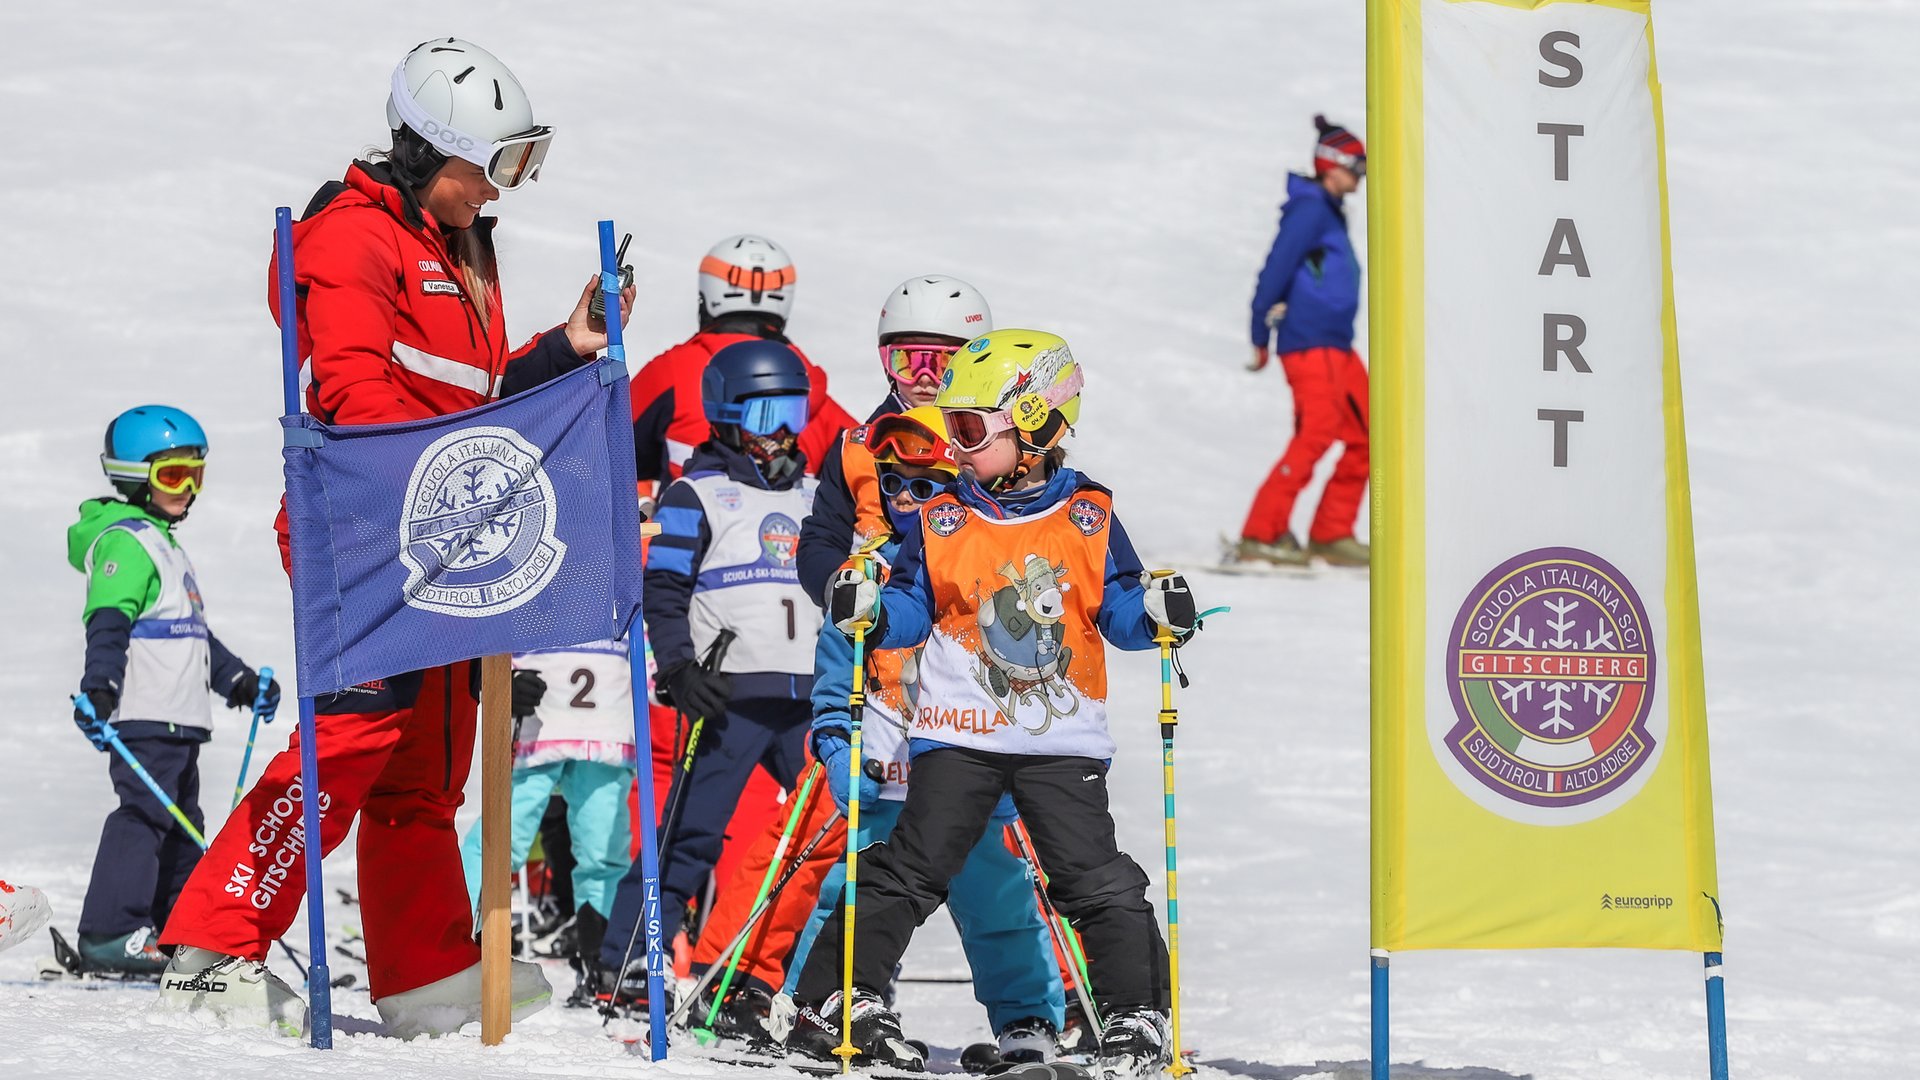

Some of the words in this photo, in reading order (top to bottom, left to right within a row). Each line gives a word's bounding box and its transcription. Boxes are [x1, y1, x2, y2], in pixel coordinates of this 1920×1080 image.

[421, 120, 474, 151] poc
[1537, 31, 1593, 468] START
[428, 283, 455, 291] Vanessa
[964, 313, 983, 323] uvex
[949, 395, 977, 405] uvex
[417, 453, 458, 515] SCUOLA
[458, 441, 519, 466] ITALIANA
[496, 578, 523, 599] ALTO
[522, 549, 551, 587] ADIGE
[782, 599, 796, 640] 1
[1471, 575, 1537, 645] SCUOLA
[1541, 568, 1620, 614] ITALIANA
[1618, 613, 1640, 649] SCI
[1471, 655, 1639, 676] GITSCHBERG
[569, 668, 596, 708] 2
[916, 705, 1009, 735] BRIMELLA
[1469, 737, 1543, 790] SÜDTIROL
[1565, 767, 1599, 791] ALTO
[1600, 739, 1636, 780] ADIGE
[224, 862, 256, 898] SKI
[248, 775, 304, 858] SCHOO
[250, 791, 331, 910] GITSCHBG
[1614, 894, 1673, 909] eurogripp
[647, 885, 660, 970] LISKI
[165, 979, 228, 993] HEAD
[800, 1006, 840, 1037] NORDICA
